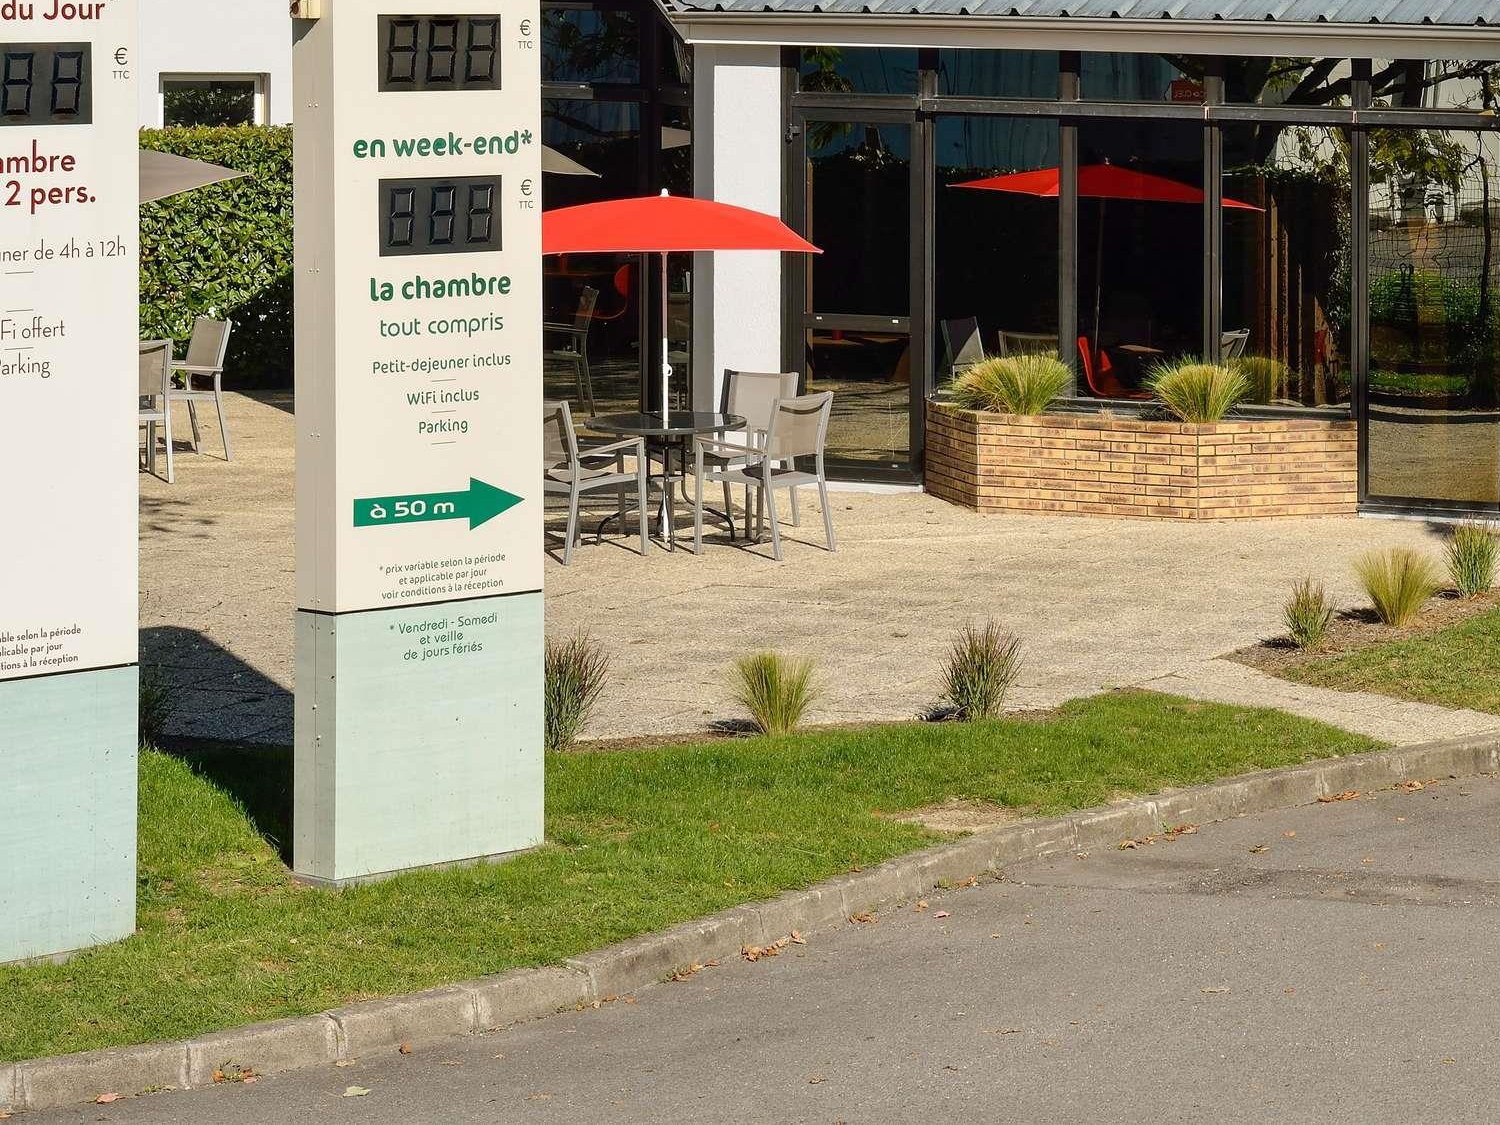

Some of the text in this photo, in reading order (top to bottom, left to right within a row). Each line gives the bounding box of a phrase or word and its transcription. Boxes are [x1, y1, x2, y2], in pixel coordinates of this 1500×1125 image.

[518, 41, 533, 49] TTC
[112, 70, 130, 79] TTC
[0, 139, 76, 174] mbre
[353, 139, 386, 158] en
[5, 180, 96, 214] 2 pers.
[519, 200, 533, 209] TTC
[0, 235, 126, 262] ner de 4h à 12h
[370, 273, 511, 301] la chambre
[21, 316, 65, 339] offert
[380, 312, 504, 338] tout compris
[0, 352, 51, 379] arking
[372, 353, 511, 374] Petit-dejeuner inclus
[407, 389, 479, 405] WiFi inclus
[418, 419, 468, 434] Parking
[370, 500, 455, 518] à 50 m
[385, 564, 403, 576] prix
[405, 560, 438, 573] variable
[440, 556, 463, 568] selon
[464, 555, 473, 565] la
[474, 552, 506, 566] période
[399, 567, 487, 586] et applicable par jour
[381, 588, 399, 600] voir
[400, 585, 446, 598] conditions
[454, 582, 462, 592] la
[463, 578, 504, 592] réception
[17, 629, 39, 641] selon
[40, 627, 48, 638] la
[49, 623, 81, 640] période
[398, 618, 448, 635] Vendredi
[457, 612, 498, 628] Samedi
[419, 630, 464, 645] et veille
[0, 642, 63, 657] licable par jour
[403, 641, 483, 661] de jours fériés
[23, 659, 28, 668] à
[29, 656, 37, 667] la
[39, 653, 79, 666] réception
